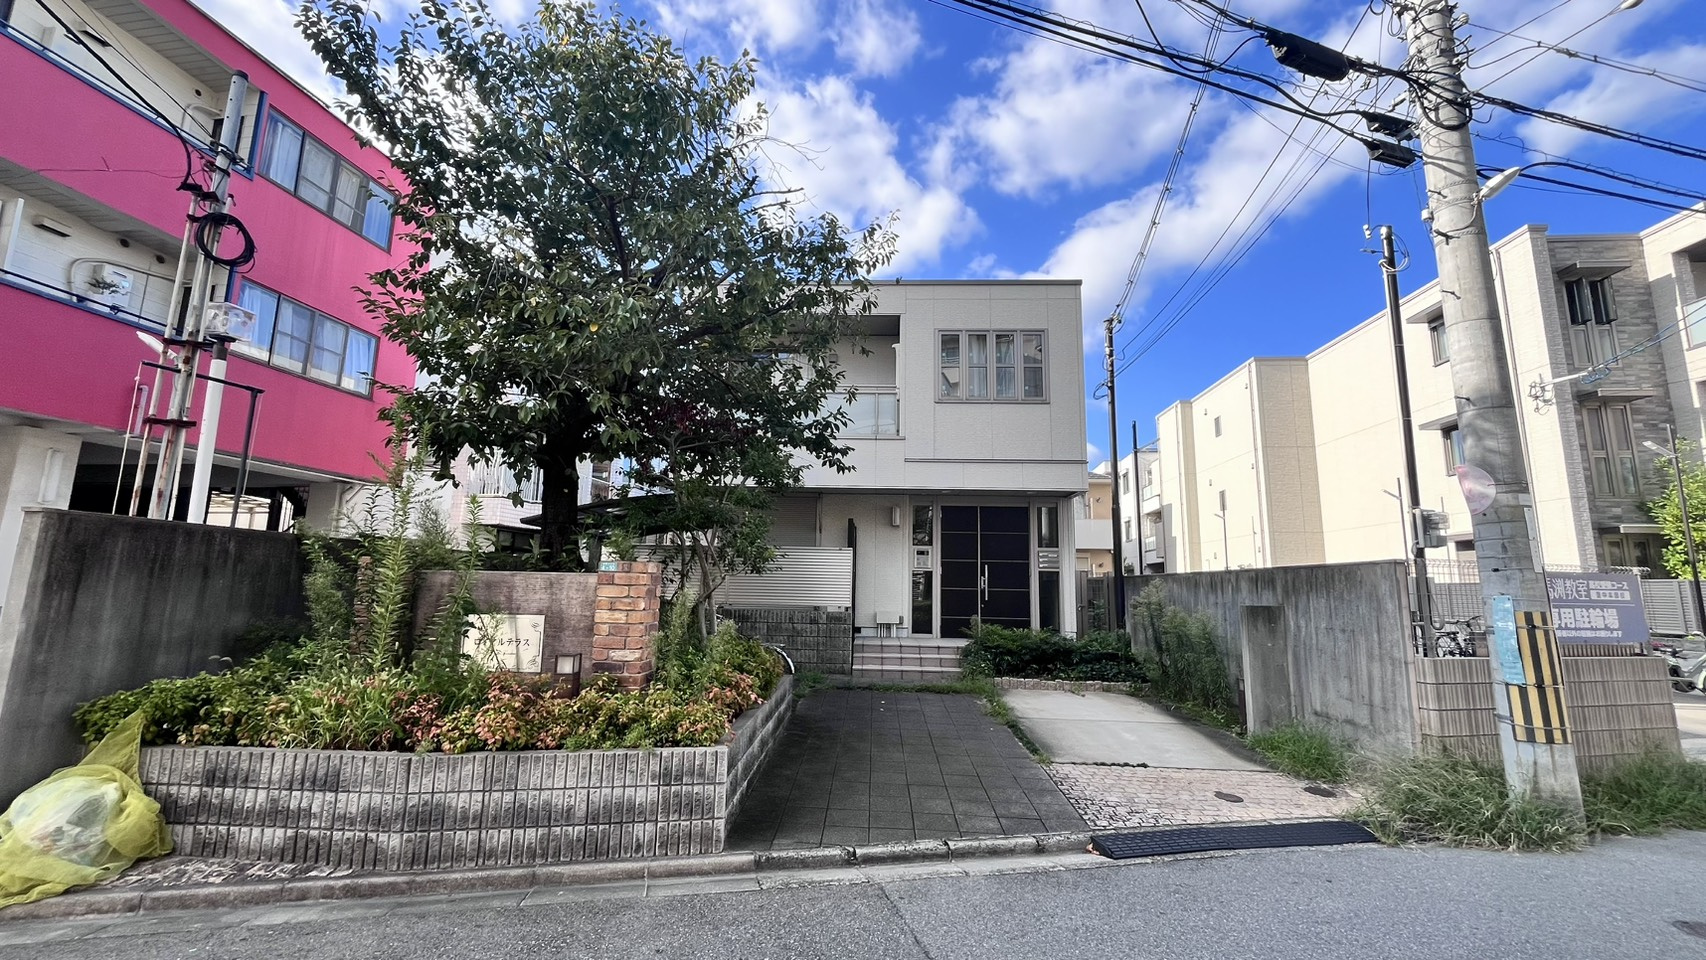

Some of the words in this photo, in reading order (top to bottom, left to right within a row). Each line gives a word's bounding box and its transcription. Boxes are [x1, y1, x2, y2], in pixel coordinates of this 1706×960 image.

[474, 638, 530, 647] ロイルテラス
